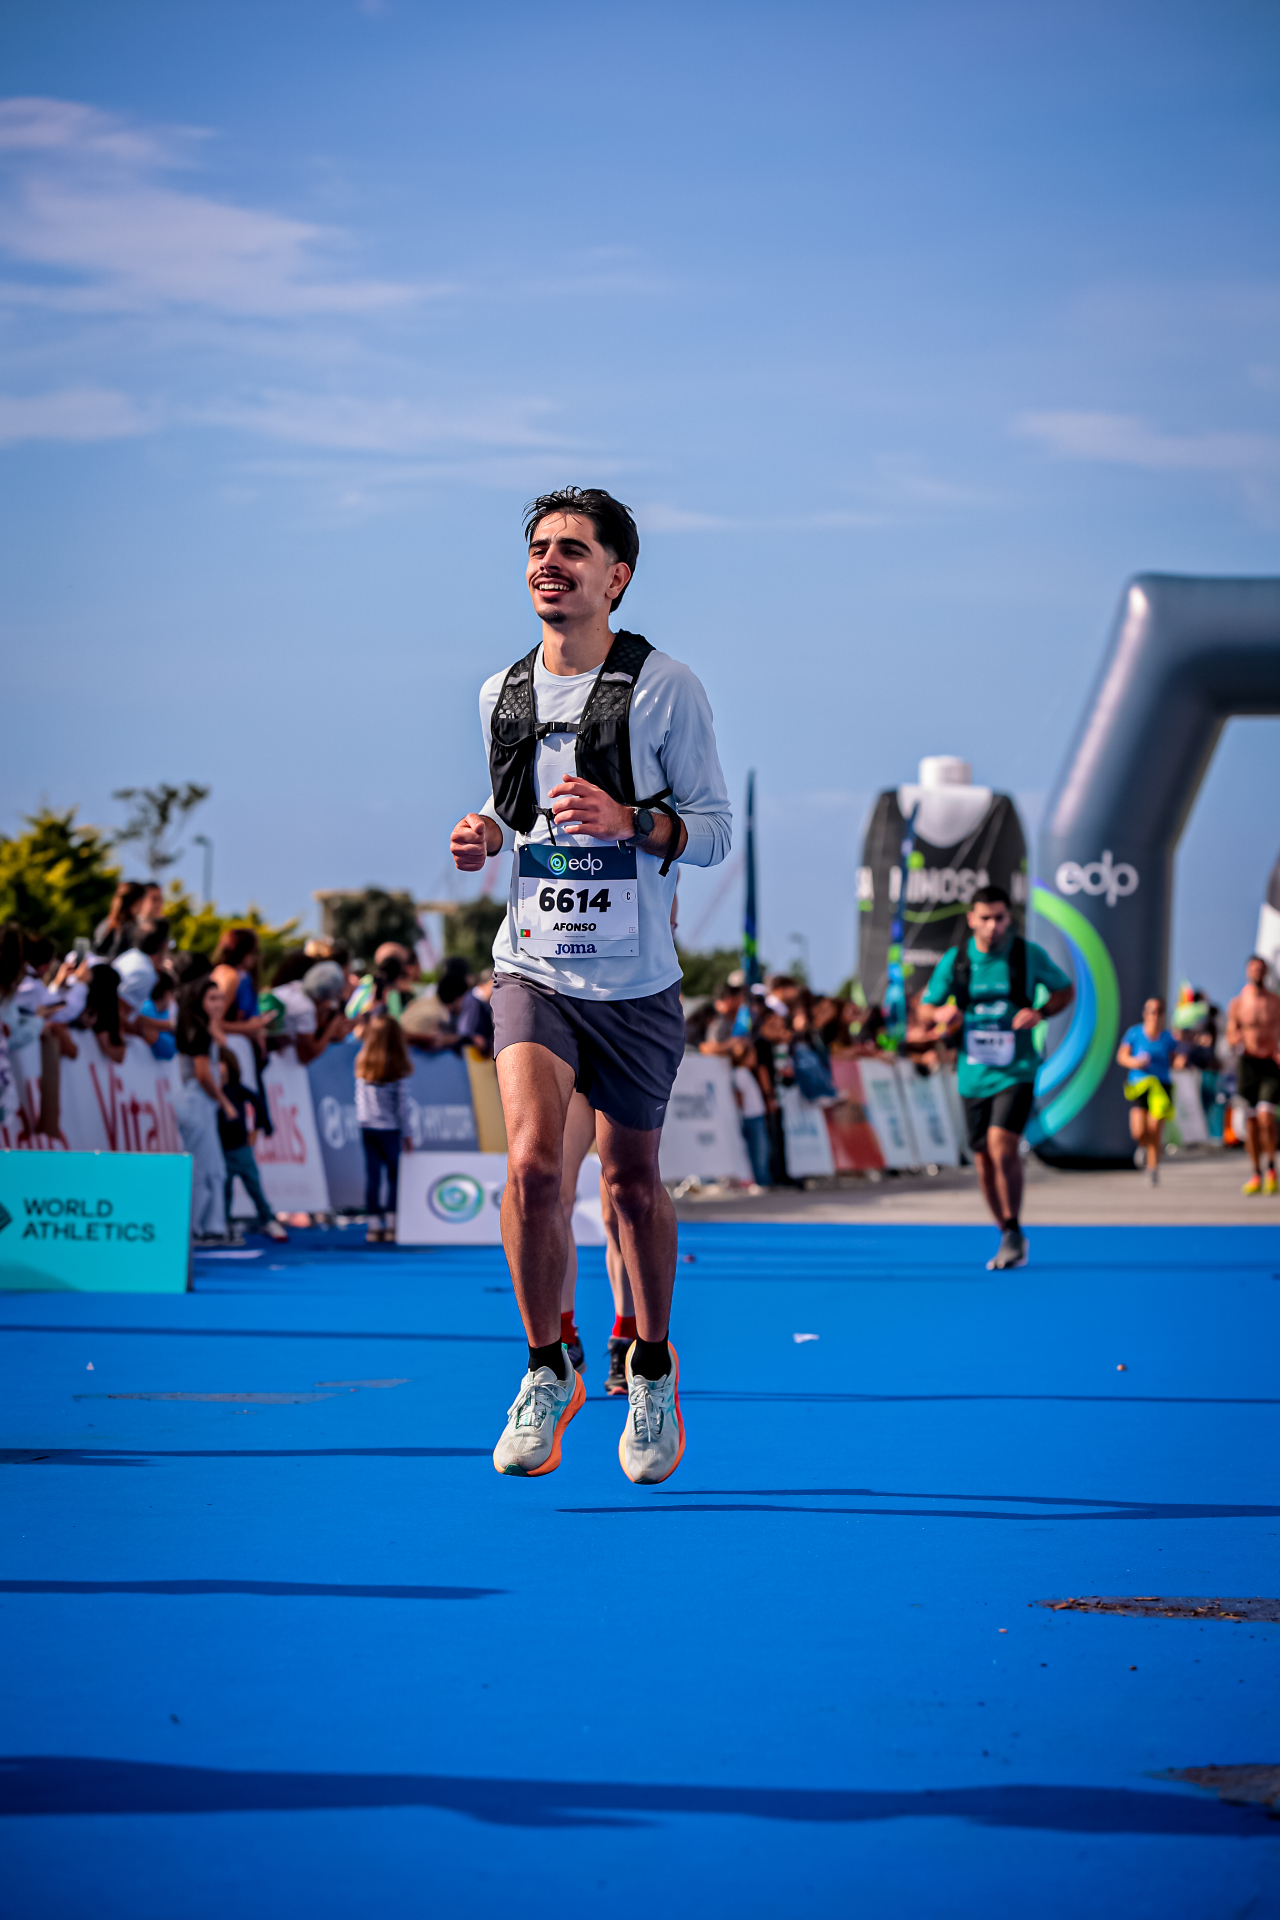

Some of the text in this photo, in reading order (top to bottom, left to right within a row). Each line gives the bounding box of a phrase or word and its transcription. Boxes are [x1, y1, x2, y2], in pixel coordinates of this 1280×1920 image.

[568, 853, 603, 875] edp
[1055, 850, 1139, 906] edp
[539, 887, 611, 913] 6614
[626, 891, 631, 901] C
[553, 922, 597, 932] AFONSO
[555, 943, 597, 955] Joma
[22, 1197, 113, 1218] WORLD
[21, 1221, 155, 1243] ATHLETICS
